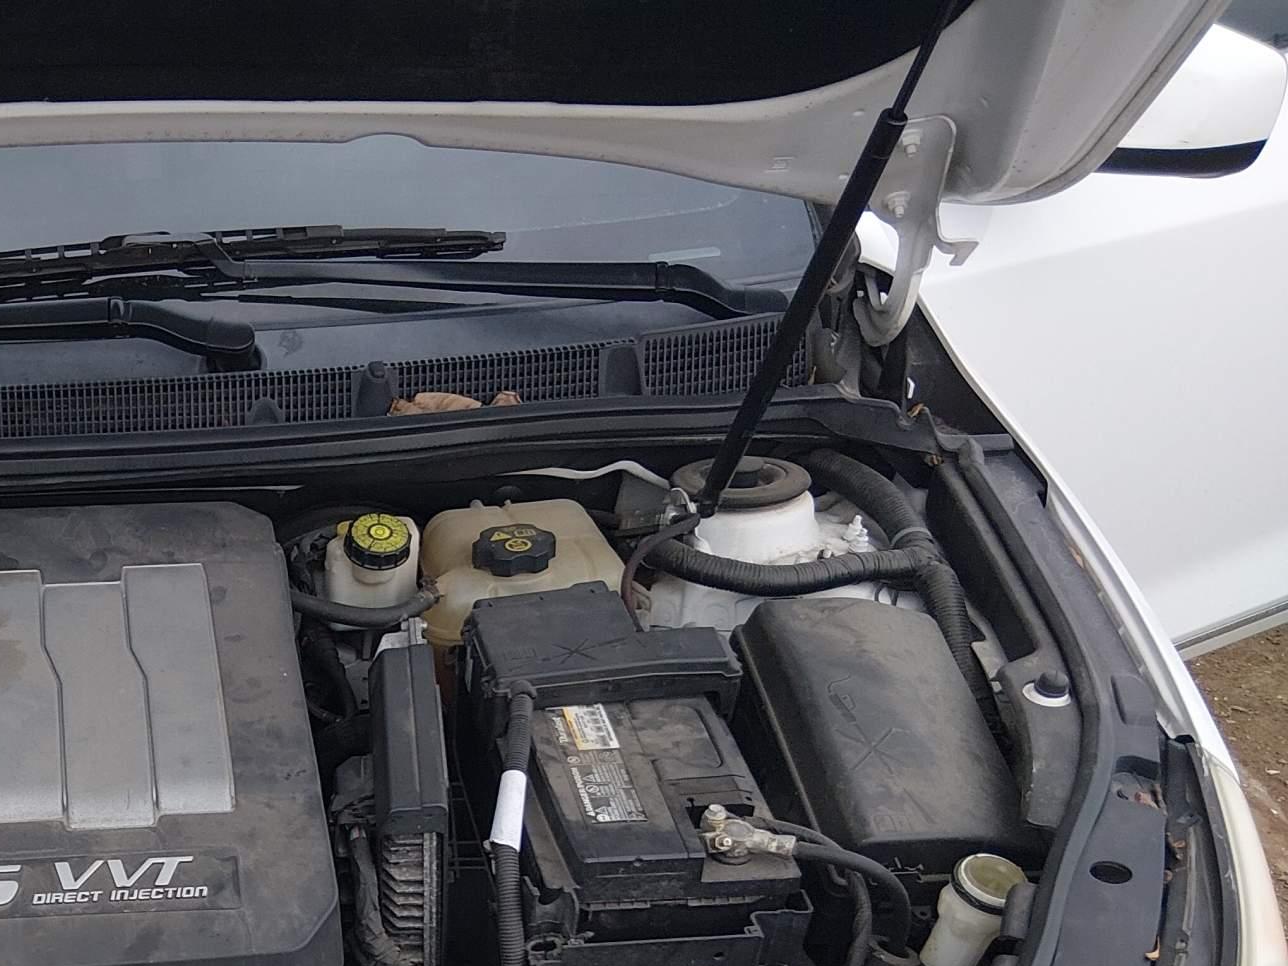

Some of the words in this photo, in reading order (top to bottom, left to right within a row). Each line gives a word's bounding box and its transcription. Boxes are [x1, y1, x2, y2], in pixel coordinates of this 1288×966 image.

[53, 855, 193, 890] VVT
[32, 890, 104, 905] DIRECT
[109, 886, 209, 902] INJECTION
